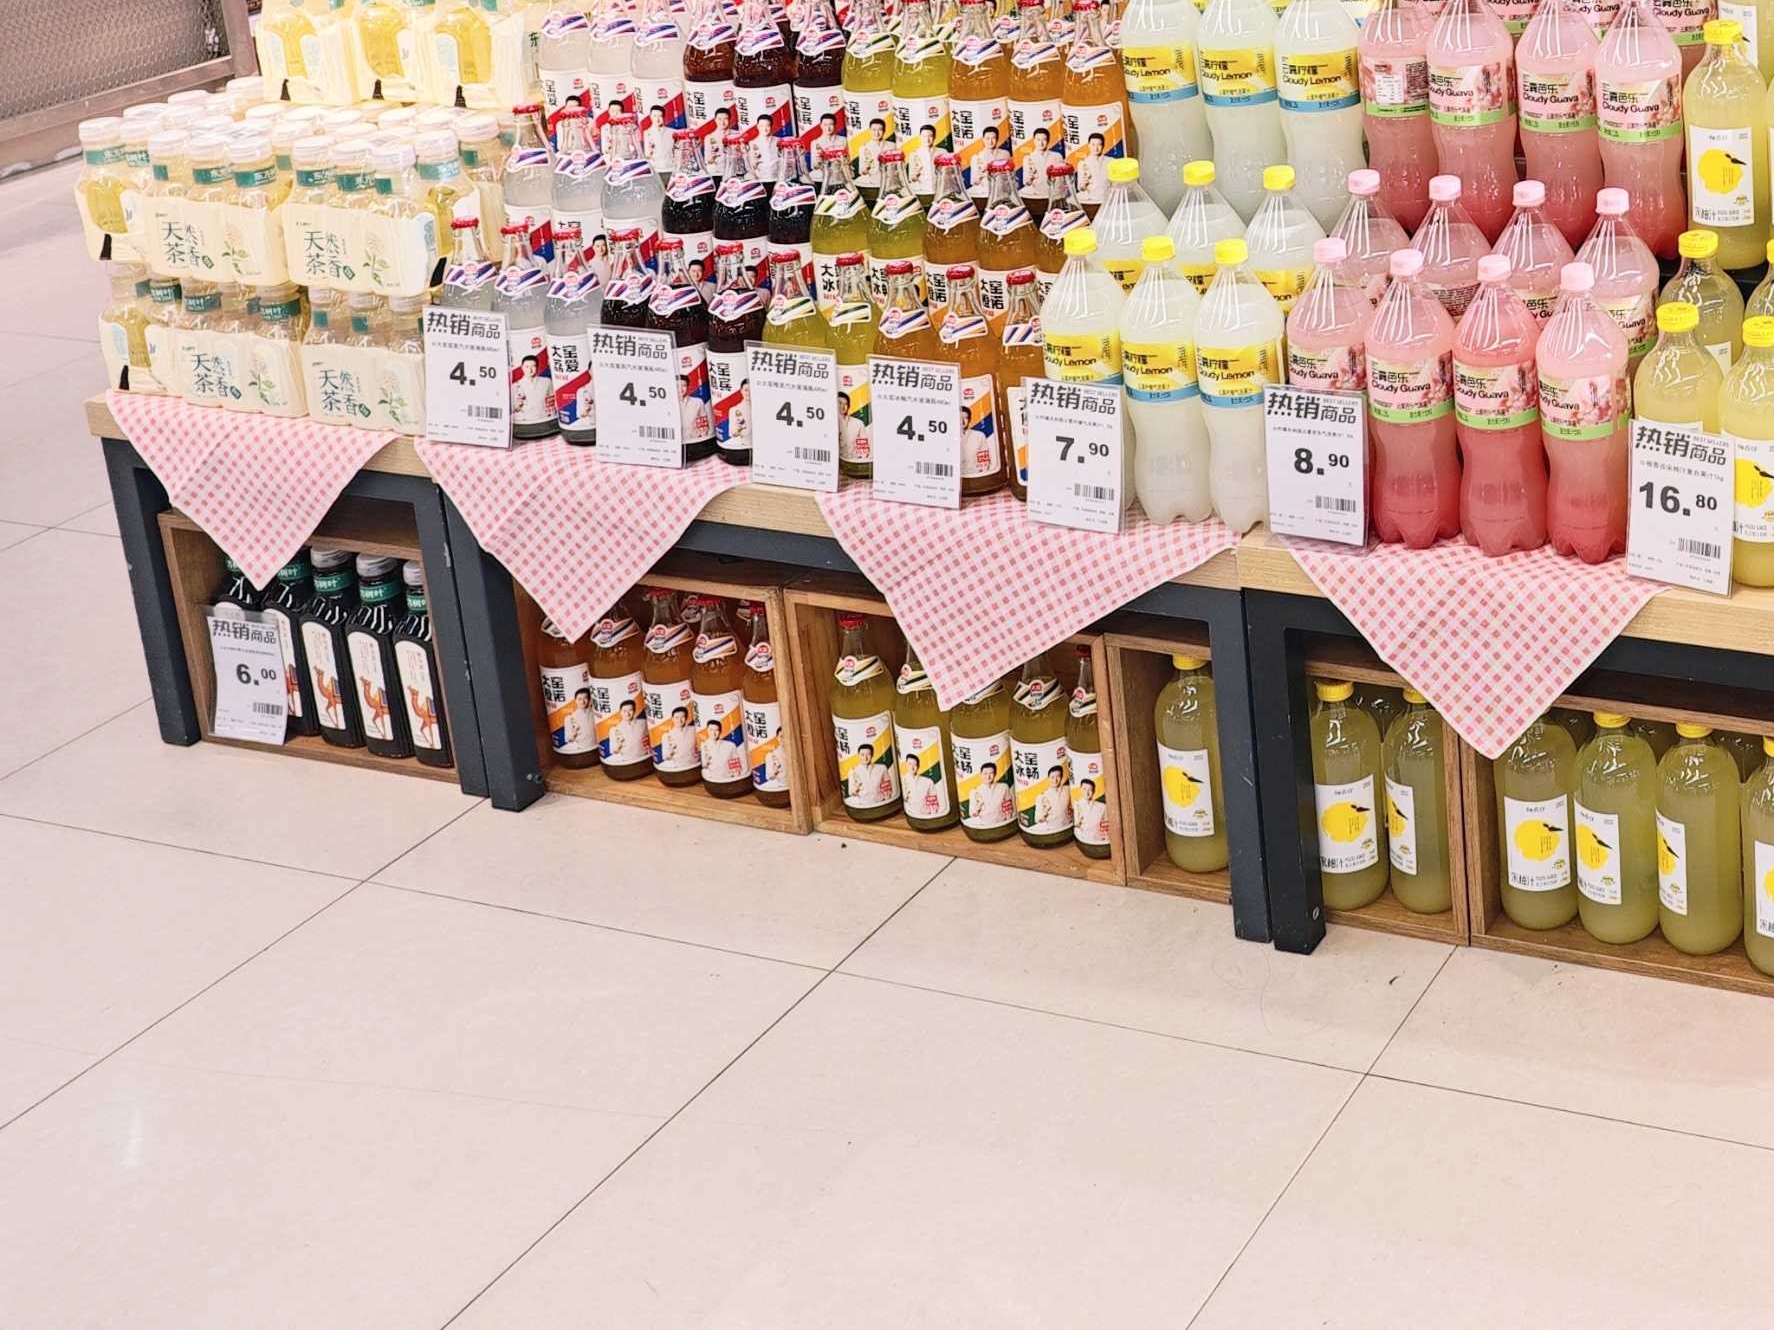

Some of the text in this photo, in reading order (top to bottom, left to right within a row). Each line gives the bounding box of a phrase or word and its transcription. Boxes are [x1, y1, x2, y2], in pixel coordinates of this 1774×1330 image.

[1220, 72, 1252, 81] Lemon
[1310, 75, 1341, 85] Lemon
[1446, 88, 1474, 96] Guava
[1549, 94, 1579, 104] Guava
[1630, 104, 1660, 112] Guava
[427, 311, 501, 339] 热销商品
[593, 332, 668, 360] 热销商品
[450, 361, 497, 386] 4.50
[751, 350, 829, 379] 热销商品
[1063, 357, 1096, 366] Lemon
[872, 363, 953, 392] 热销商品
[1220, 371, 1255, 380] Lemon
[1308, 371, 1339, 381] Guava
[1400, 381, 1432, 392] Guava
[619, 382, 666, 406] 4.50
[1030, 381, 1116, 415] 热销商品
[1478, 390, 1510, 400] Guava
[1551, 401, 1581, 410] Guava
[776, 401, 825, 427] 4.50
[1266, 391, 1356, 424] 热销商品
[896, 415, 948, 442] 4.50
[1055, 435, 1109, 464] 7.90
[1635, 425, 1726, 466] 热销商品
[1294, 448, 1349, 476] 8.90
[1639, 481, 1718, 517] 16.80
[212, 622, 277, 644] 热销商品
[236, 664, 277, 686] 6.00
